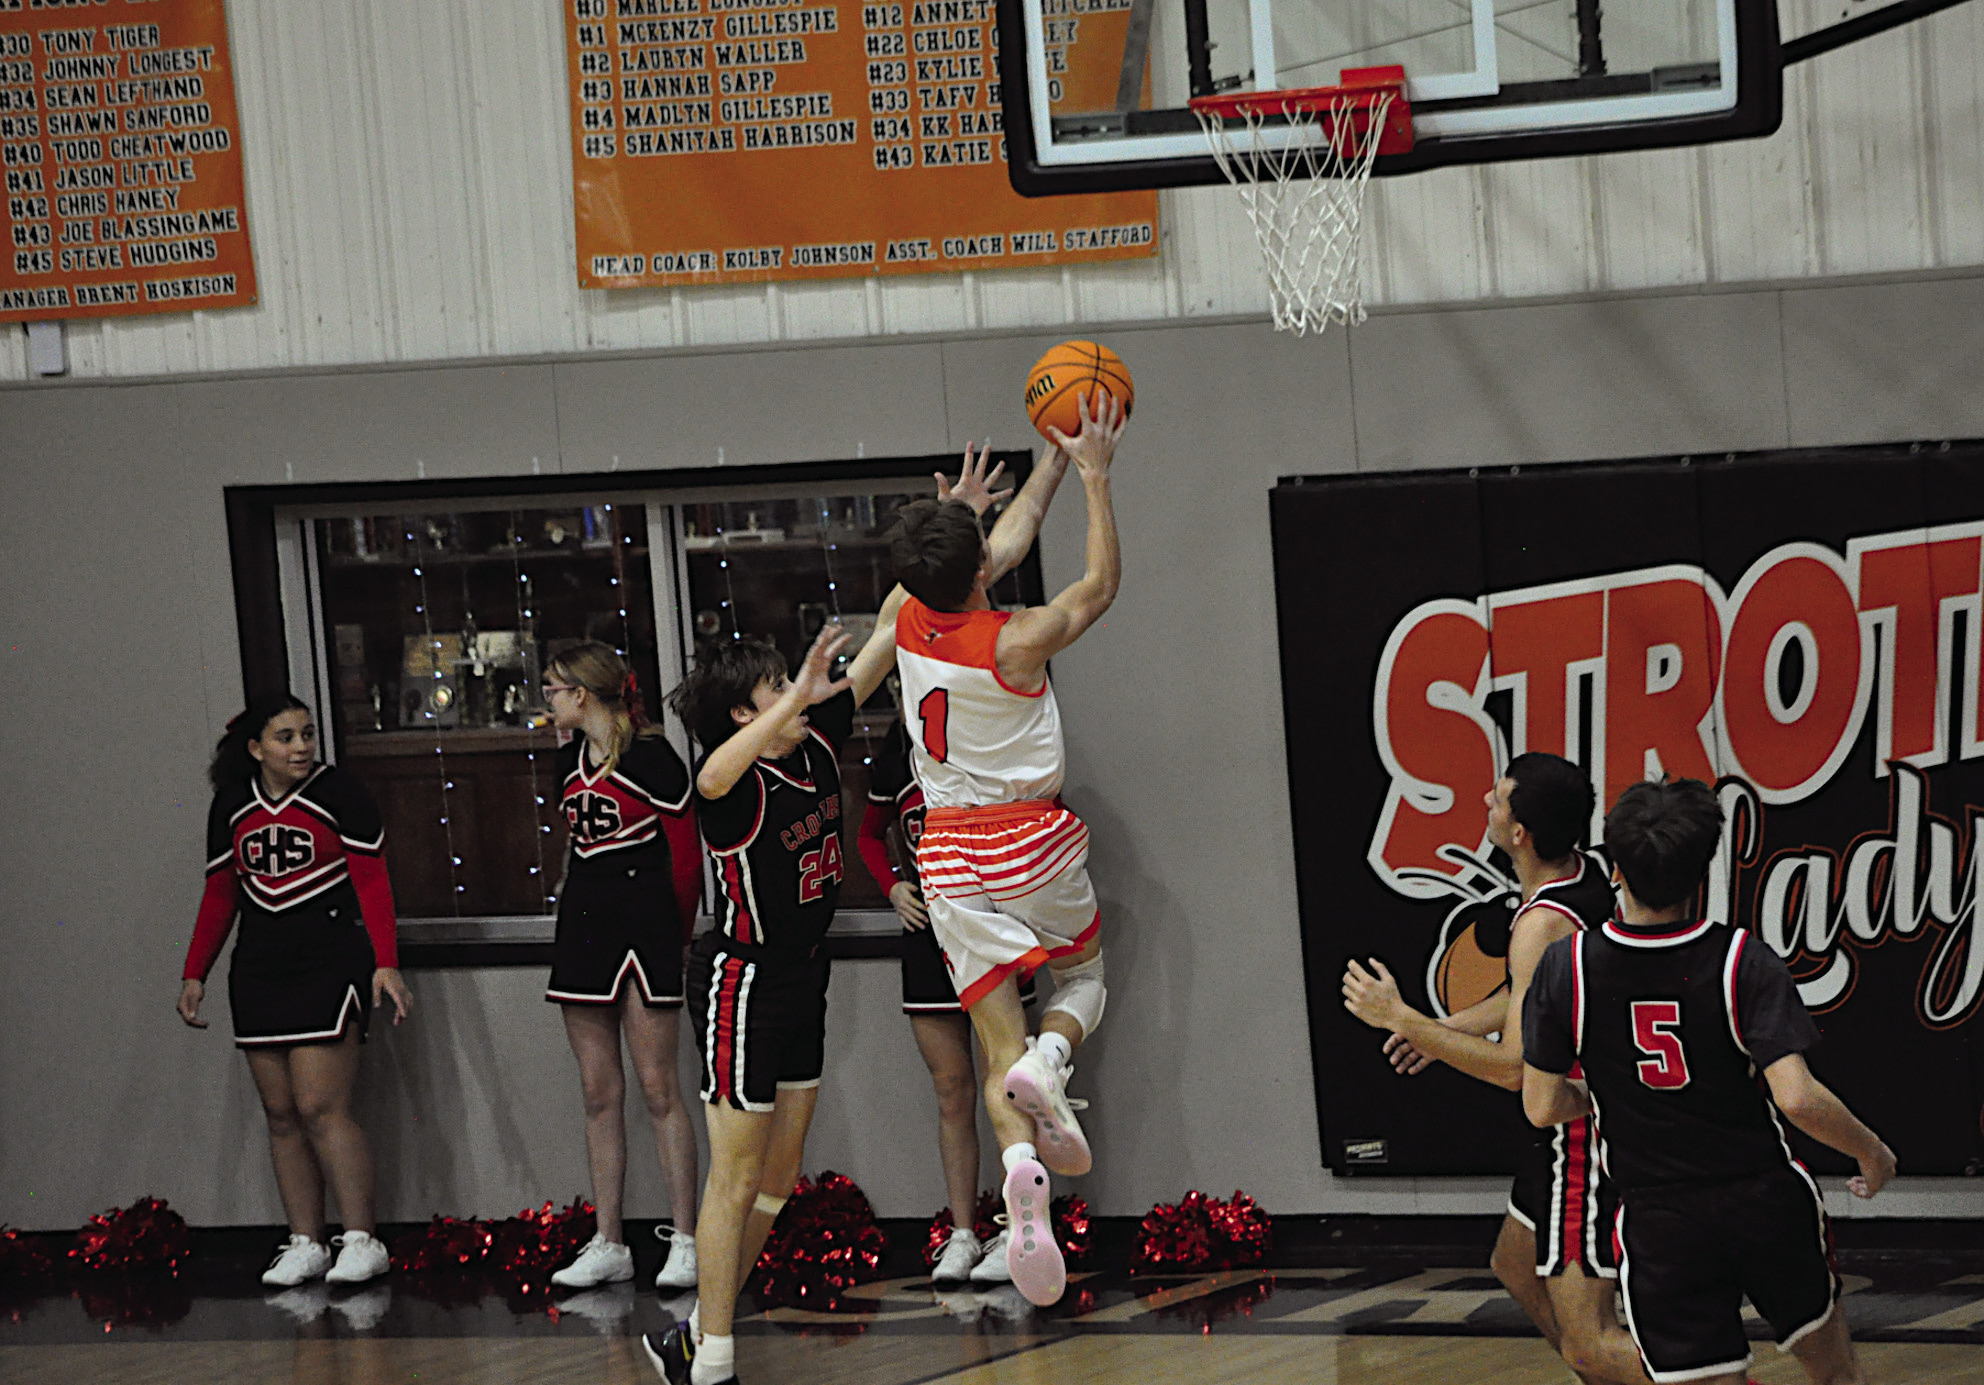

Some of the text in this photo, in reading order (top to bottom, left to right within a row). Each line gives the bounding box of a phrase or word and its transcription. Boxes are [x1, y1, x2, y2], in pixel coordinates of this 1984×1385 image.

[577, 8, 837, 46] #1 MCKENZY GILLESPIE
[862, 0, 997, 29] #12 ANNET
[39, 28, 95, 54] TONY
[104, 23, 160, 50] TIGER
[865, 33, 905, 57] #22
[913, 27, 982, 53] CHLOE
[42, 55, 120, 82] JOHNNY
[129, 46, 214, 76] LONGEST
[579, 40, 806, 74] #2 LAURYN WALLER
[867, 61, 907, 86] #23
[915, 54, 983, 82] KYLIE
[0, 76, 204, 112] #34 SEAN LEFTHAND
[582, 68, 776, 102] #3 HANNAH SAPP
[869, 88, 910, 113] #33
[0, 103, 211, 139] #35 SHAWN SANFORD
[584, 91, 832, 129] #4 MADLYN GILLESPIE
[872, 115, 912, 141] #34
[920, 112, 951, 139] KK
[4, 129, 231, 166] #40 TODD CHEATWOOD
[584, 121, 858, 158] #5 SHANIYAH HARRISON
[873, 143, 914, 170] #43
[922, 140, 992, 168] KATIE
[6, 158, 197, 193] #41 JASON LITTLE
[9, 186, 182, 220] #42 CHRIS HANEY
[12, 208, 240, 247] #43 JOE BLASSINGAME
[15, 238, 217, 274] #45 STEVE HUDGINS
[592, 255, 646, 277] HEAD
[724, 247, 783, 271] KOLBY
[791, 242, 876, 266] JOHNSON
[886, 239, 937, 262] ASST.
[943, 233, 1003, 258] COACH
[1010, 230, 1058, 254] WILL
[1064, 222, 1152, 249] STAFFORD
[0, 275, 237, 311] ANAGER BRENT HOSKISON
[919, 687, 948, 763] 1
[1365, 521, 1984, 898] STROT
[239, 823, 315, 877] CHS
[799, 831, 843, 904] 24
[1630, 1001, 1690, 1090] 5
